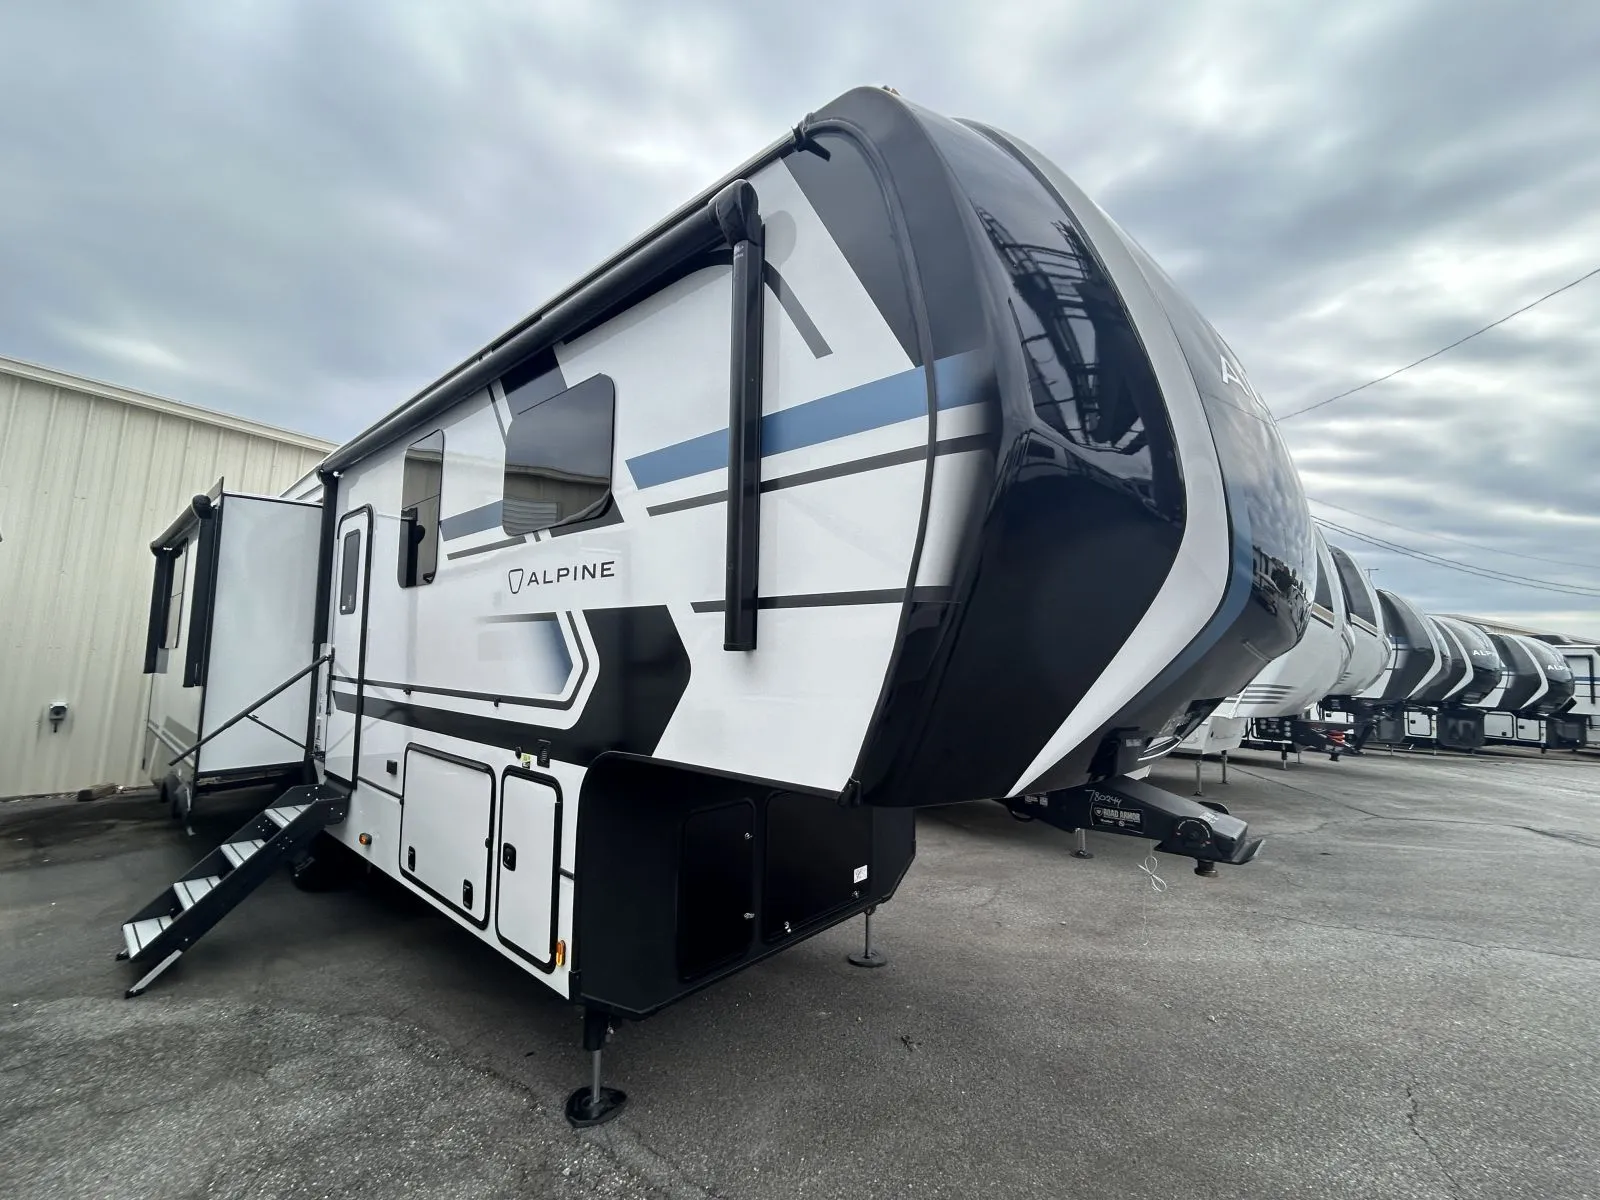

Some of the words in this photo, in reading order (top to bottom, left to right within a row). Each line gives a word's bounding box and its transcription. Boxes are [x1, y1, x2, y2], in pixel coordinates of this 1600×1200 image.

[527, 560, 615, 586] ALPINE
[1103, 808, 1119, 819] ROAD
[1119, 810, 1141, 823] ARMOR
